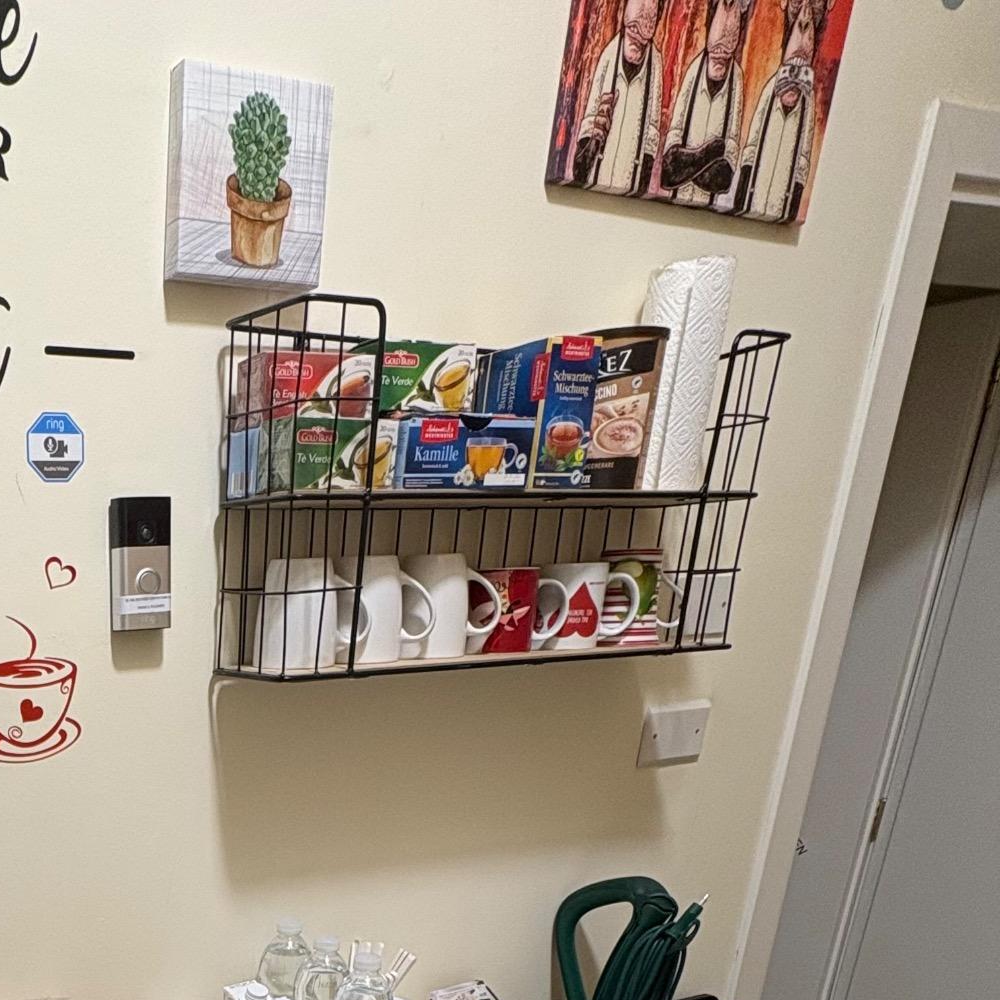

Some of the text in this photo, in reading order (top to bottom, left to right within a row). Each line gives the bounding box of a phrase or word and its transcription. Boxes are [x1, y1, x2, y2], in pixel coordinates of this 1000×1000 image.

[599, 348, 633, 373] EZ
[392, 376, 414, 386] Verde
[555, 382, 589, 398] Mischung
[46, 419, 65, 432] ring
[414, 445, 459, 461] Kamille
